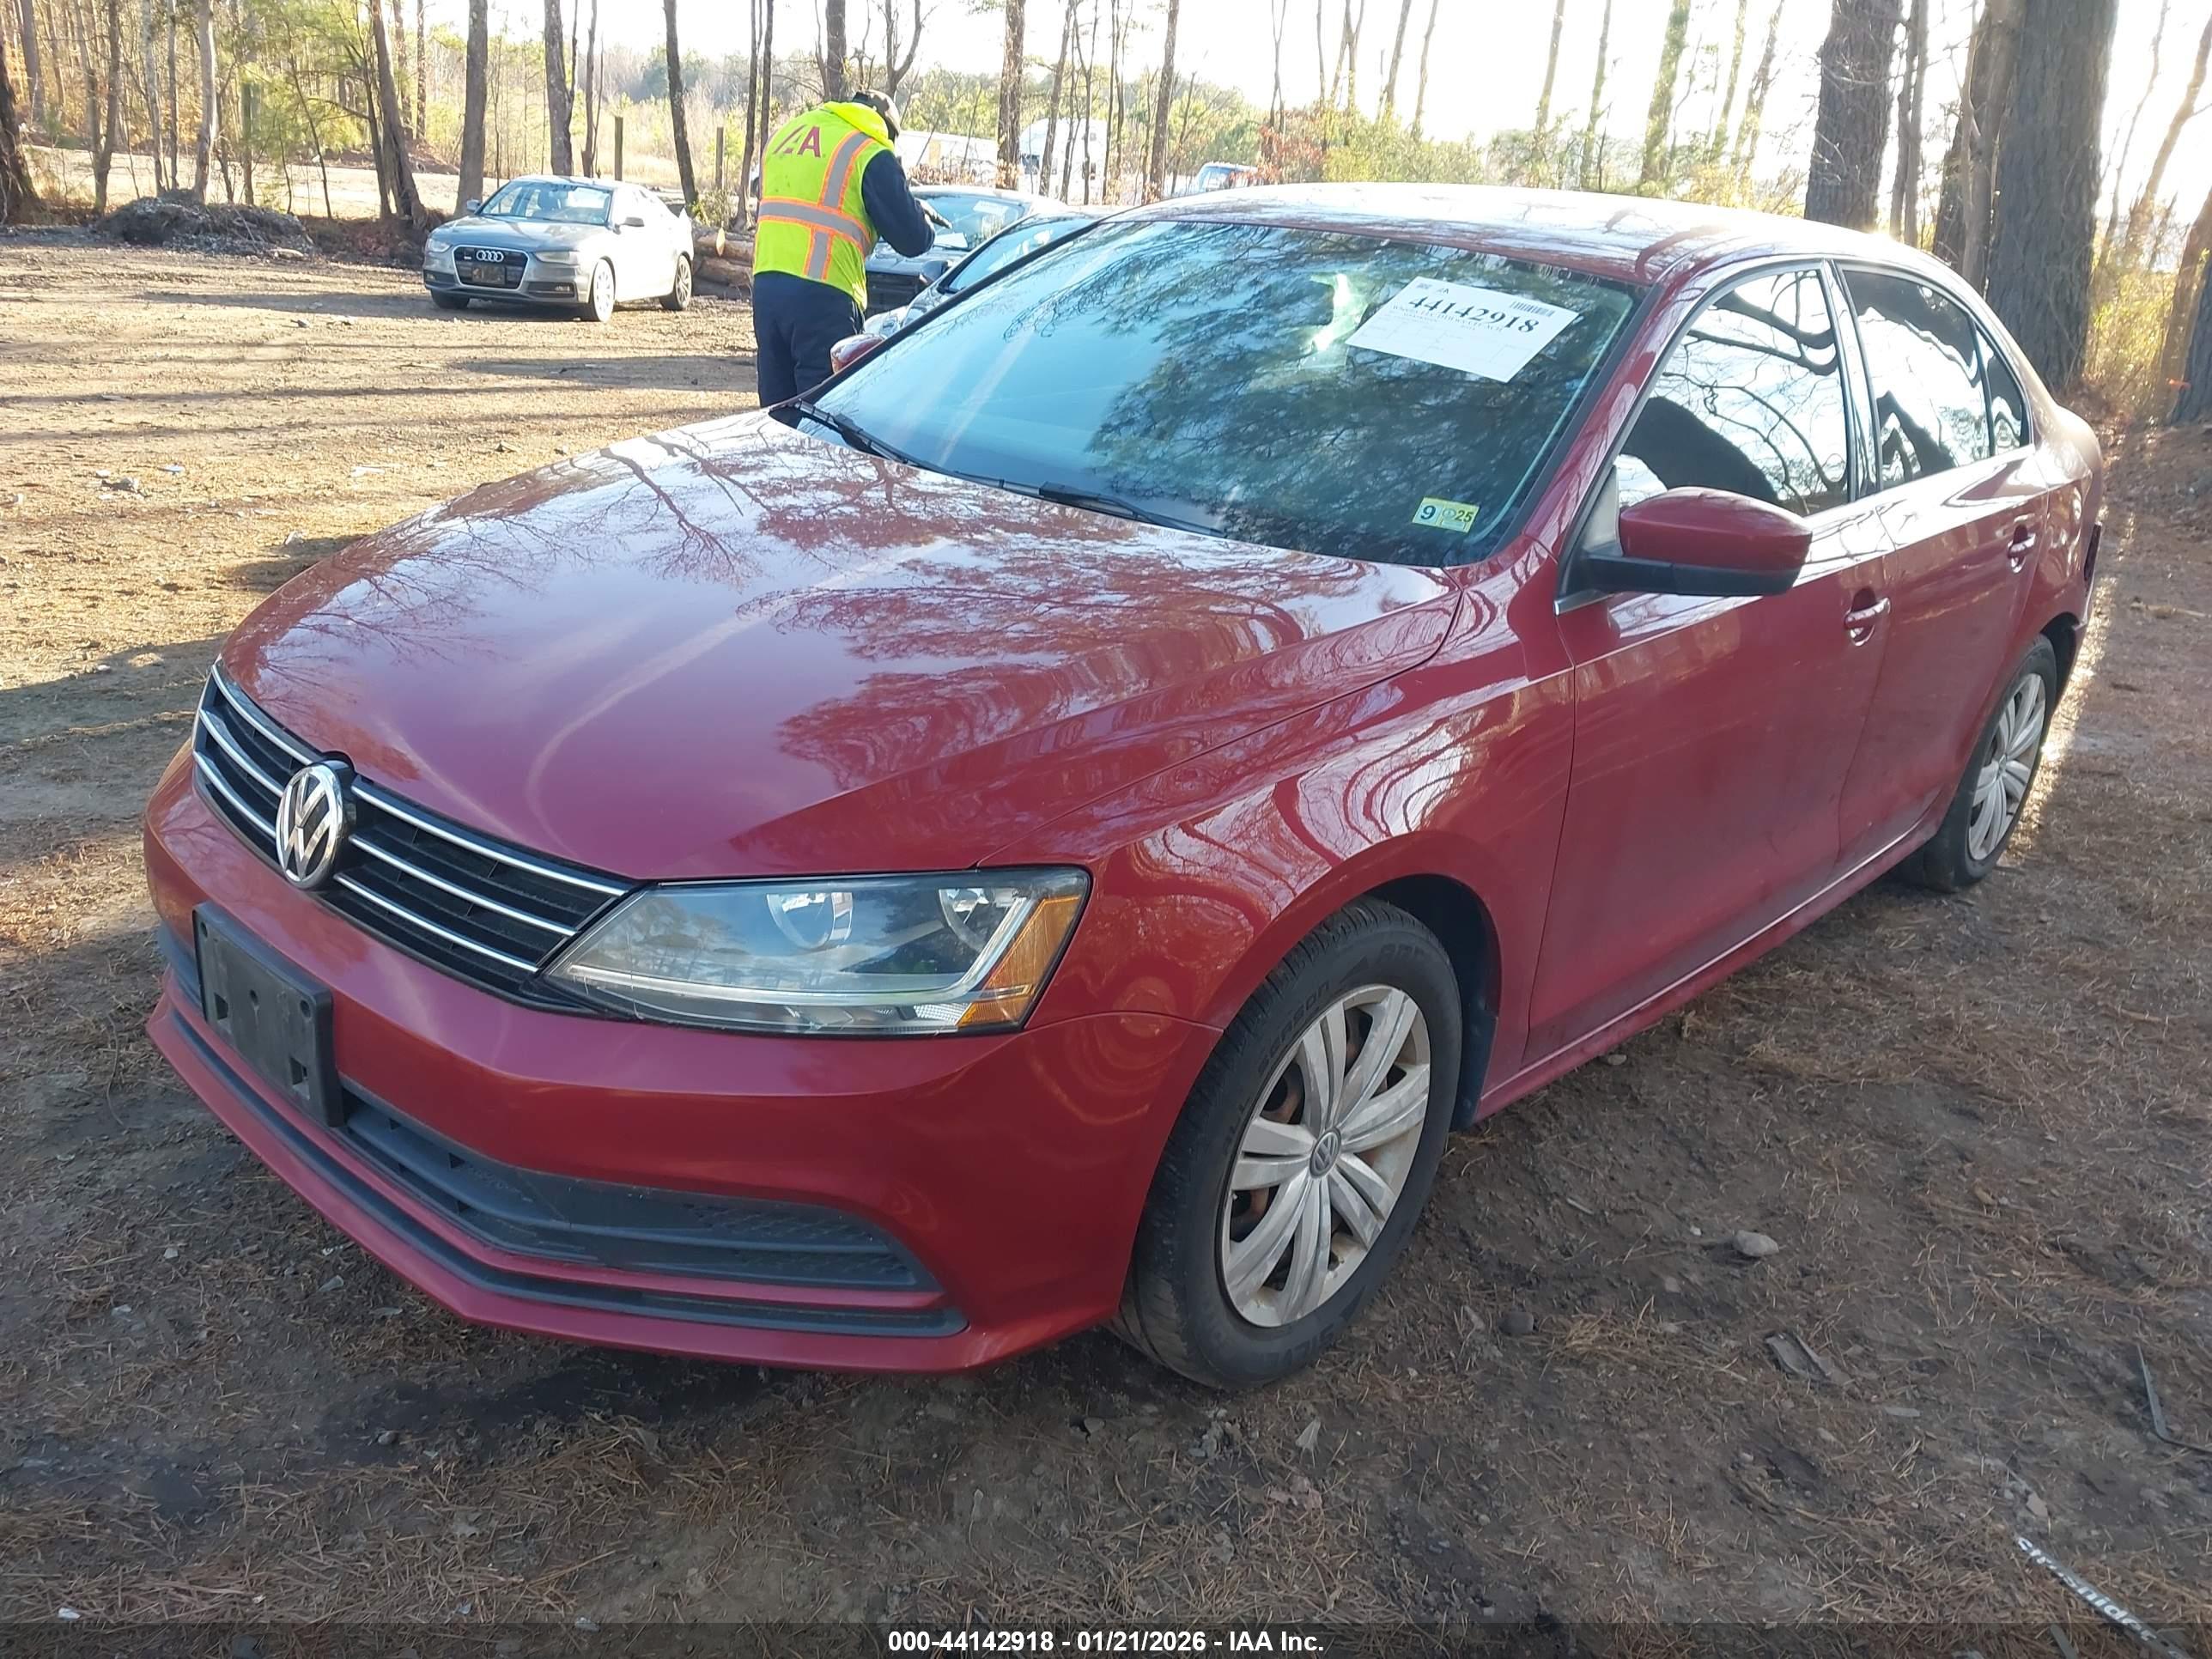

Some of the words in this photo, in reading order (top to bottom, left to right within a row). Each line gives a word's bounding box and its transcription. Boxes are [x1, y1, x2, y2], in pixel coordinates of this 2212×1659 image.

[1409, 295, 1540, 333] 44142918
[1420, 505, 1437, 520] 9
[1455, 510, 1474, 523] 25
